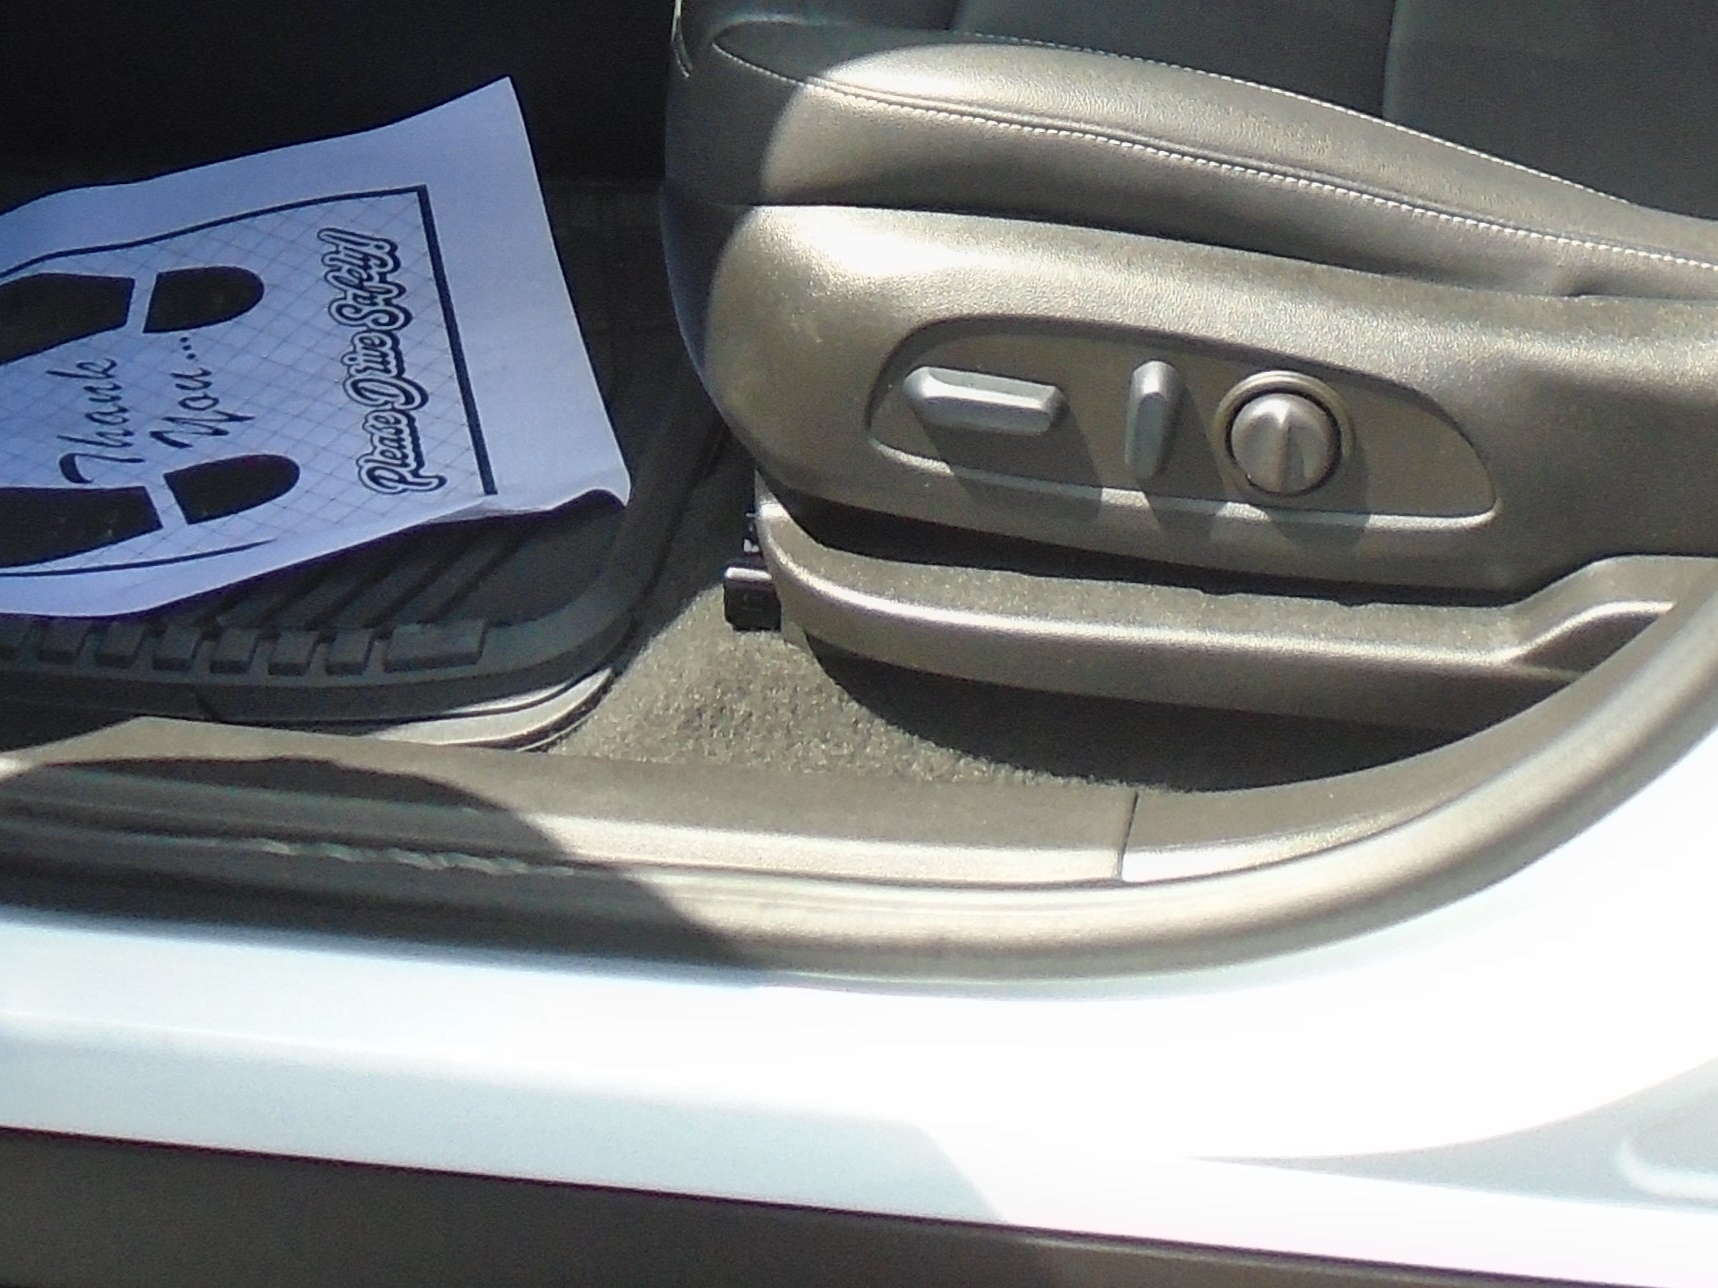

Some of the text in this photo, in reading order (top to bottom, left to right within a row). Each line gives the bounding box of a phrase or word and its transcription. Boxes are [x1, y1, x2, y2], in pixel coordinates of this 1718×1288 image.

[342, 330, 428, 411] Drive
[46, 357, 145, 483] Thank
[356, 409, 447, 494] Please
